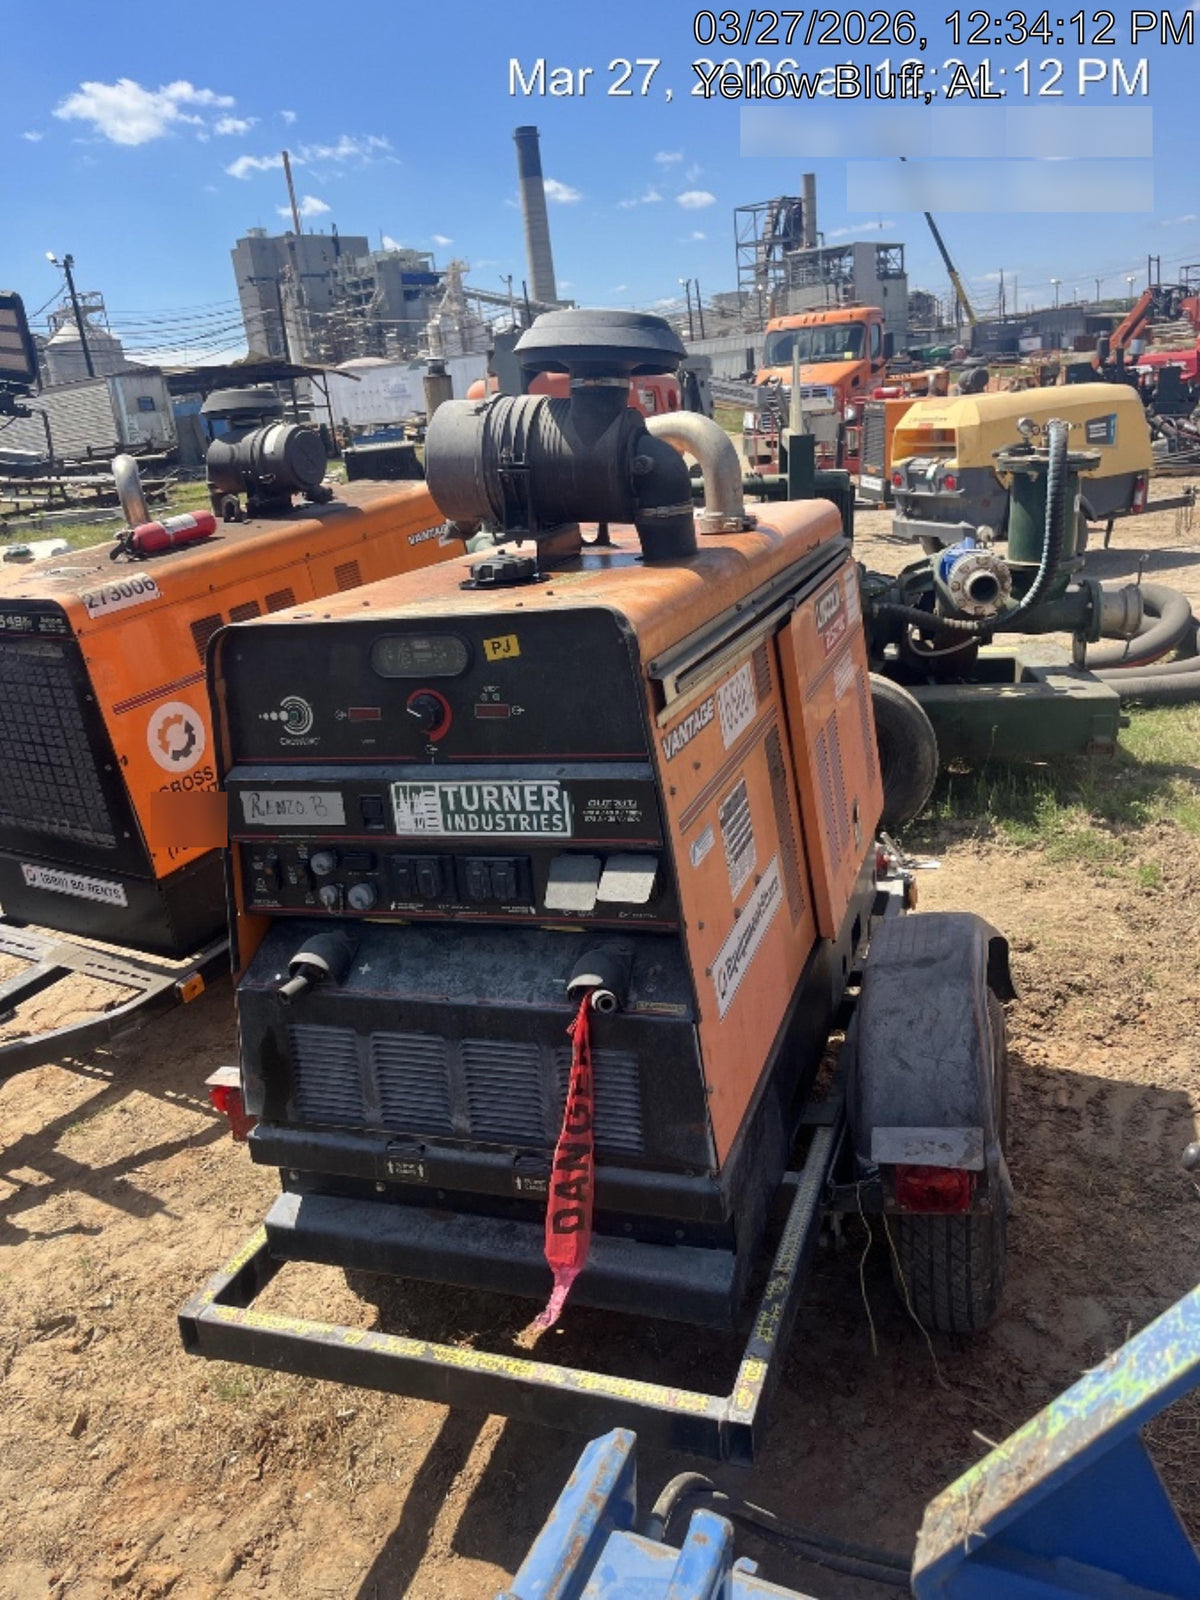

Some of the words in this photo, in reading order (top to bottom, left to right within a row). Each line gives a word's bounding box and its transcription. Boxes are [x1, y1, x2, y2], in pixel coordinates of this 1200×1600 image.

[82, 577, 156, 609] 273006
[491, 639, 512, 656] PJ
[660, 693, 716, 764] VANTAGE
[441, 784, 563, 813] TURNER
[447, 813, 564, 832] INDUSTRIES
